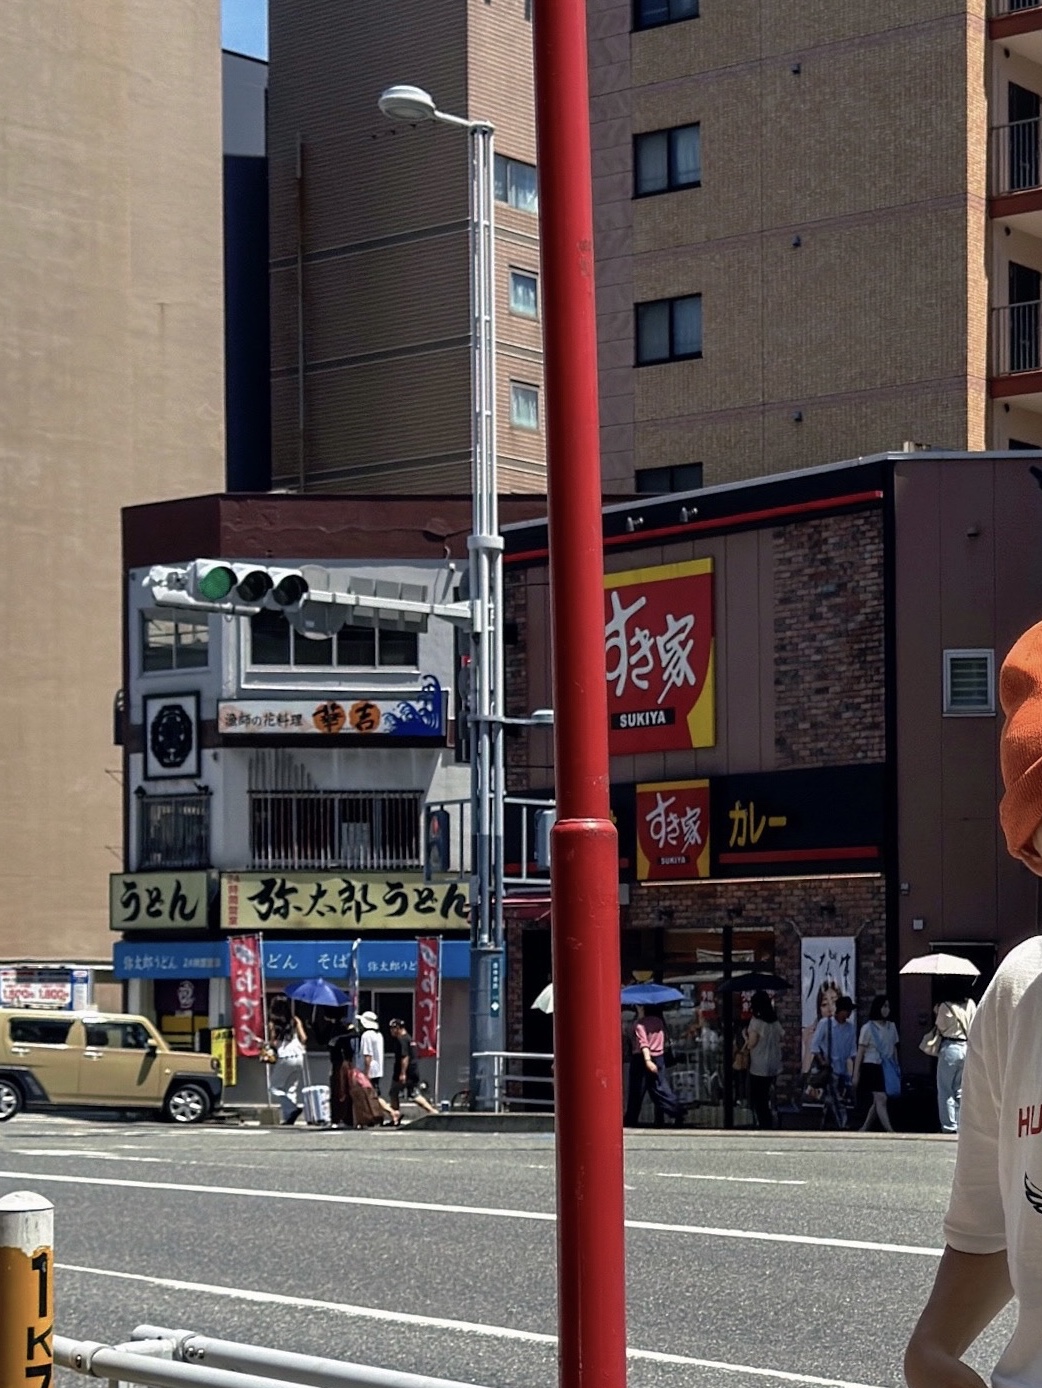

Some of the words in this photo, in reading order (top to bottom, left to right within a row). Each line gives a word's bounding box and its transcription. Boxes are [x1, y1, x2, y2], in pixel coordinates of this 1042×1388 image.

[605, 591, 696, 705] すき家
[619, 710, 667, 728] SUKIYA
[645, 792, 702, 853] すき家
[729, 800, 787, 847] カレー
[120, 878, 199, 923] うどん
[247, 877, 472, 925] 弥太郎うどん
[266, 952, 298, 970] どん
[367, 960, 417, 972] 弥太郎うど
